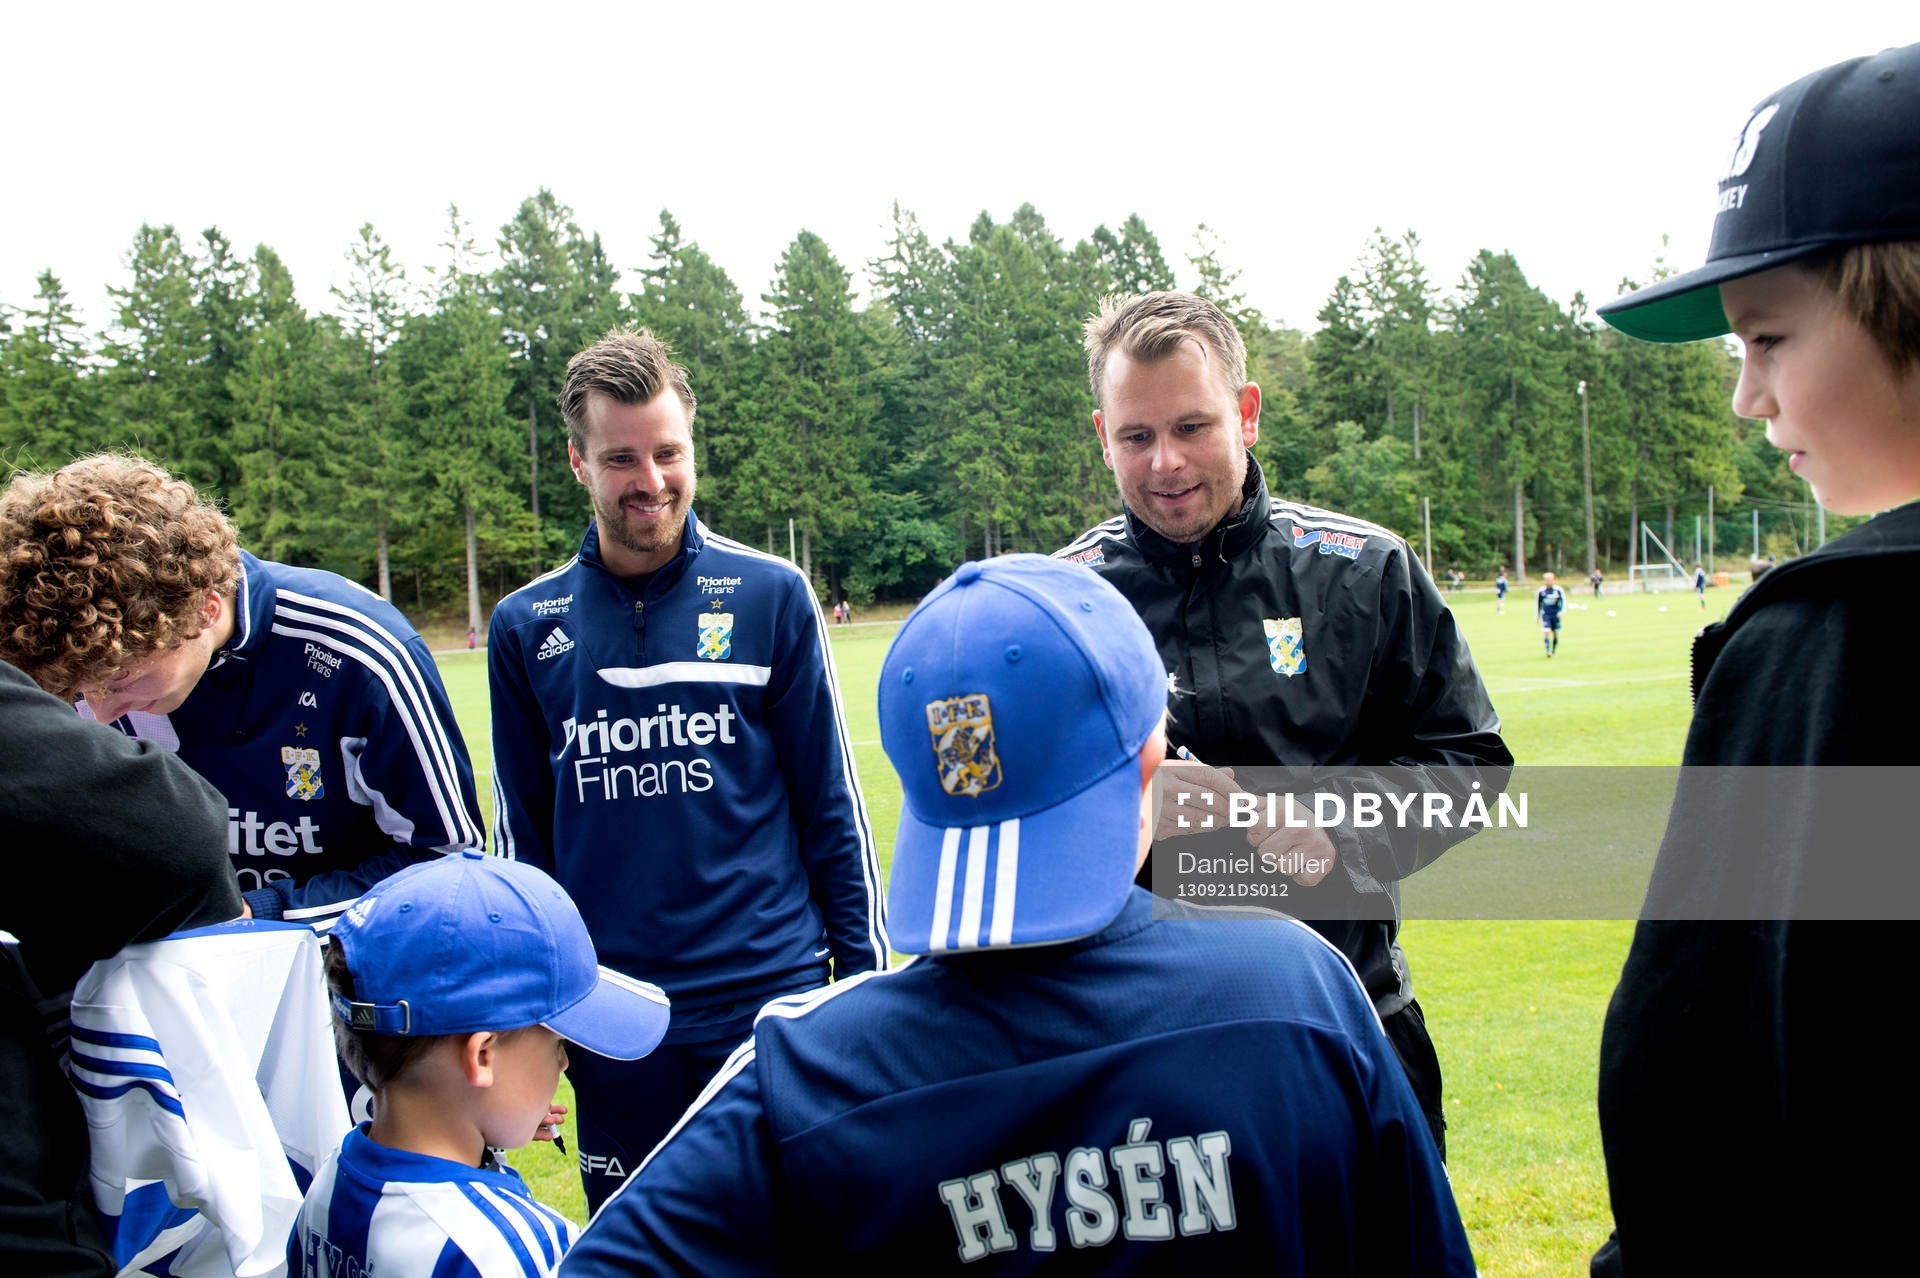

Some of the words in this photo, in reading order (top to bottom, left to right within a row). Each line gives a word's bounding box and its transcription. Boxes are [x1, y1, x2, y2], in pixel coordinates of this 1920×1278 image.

[1320, 530, 1365, 550] INTER
[1319, 543, 1361, 560] SPORT
[697, 576, 742, 587] Prioritet
[701, 585, 735, 595] Finans
[532, 593, 574, 612] Prioritet
[537, 604, 570, 617] Finans
[303, 643, 343, 670] Prioritet
[537, 640, 575, 661] adidas
[307, 657, 332, 678] Finans
[556, 703, 736, 760] Prioritet
[574, 757, 714, 803] Finans
[938, 1117, 1238, 1264] HYSÉN
